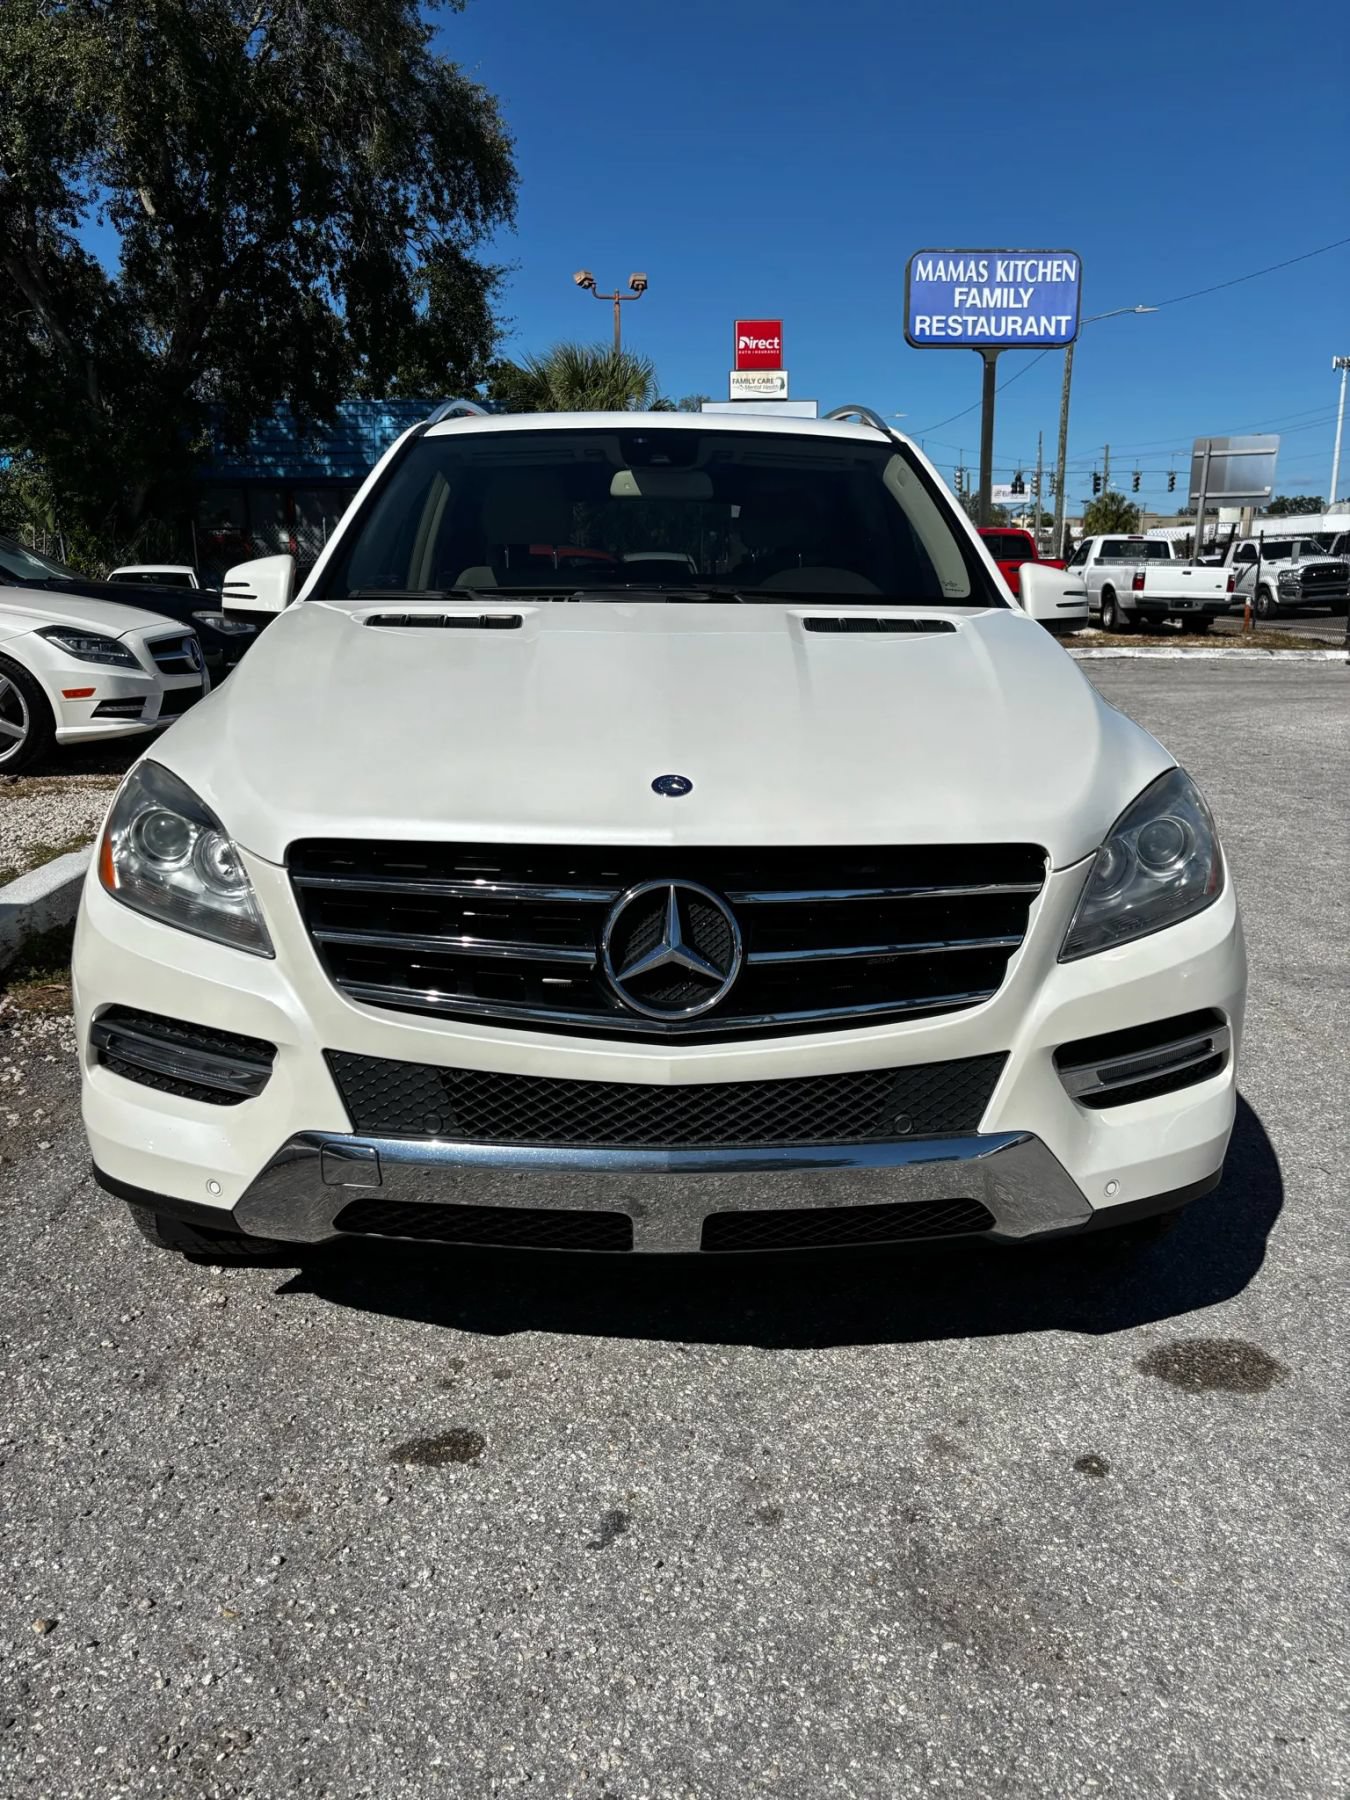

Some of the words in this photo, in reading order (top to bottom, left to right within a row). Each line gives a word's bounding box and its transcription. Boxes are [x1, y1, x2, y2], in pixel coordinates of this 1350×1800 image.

[915, 260, 988, 283] MAMAS
[996, 259, 1076, 283] KITCHEN
[954, 287, 1034, 309] FAMILY
[914, 315, 1072, 337] RESTAURANT
[739, 336, 780, 349] Direct
